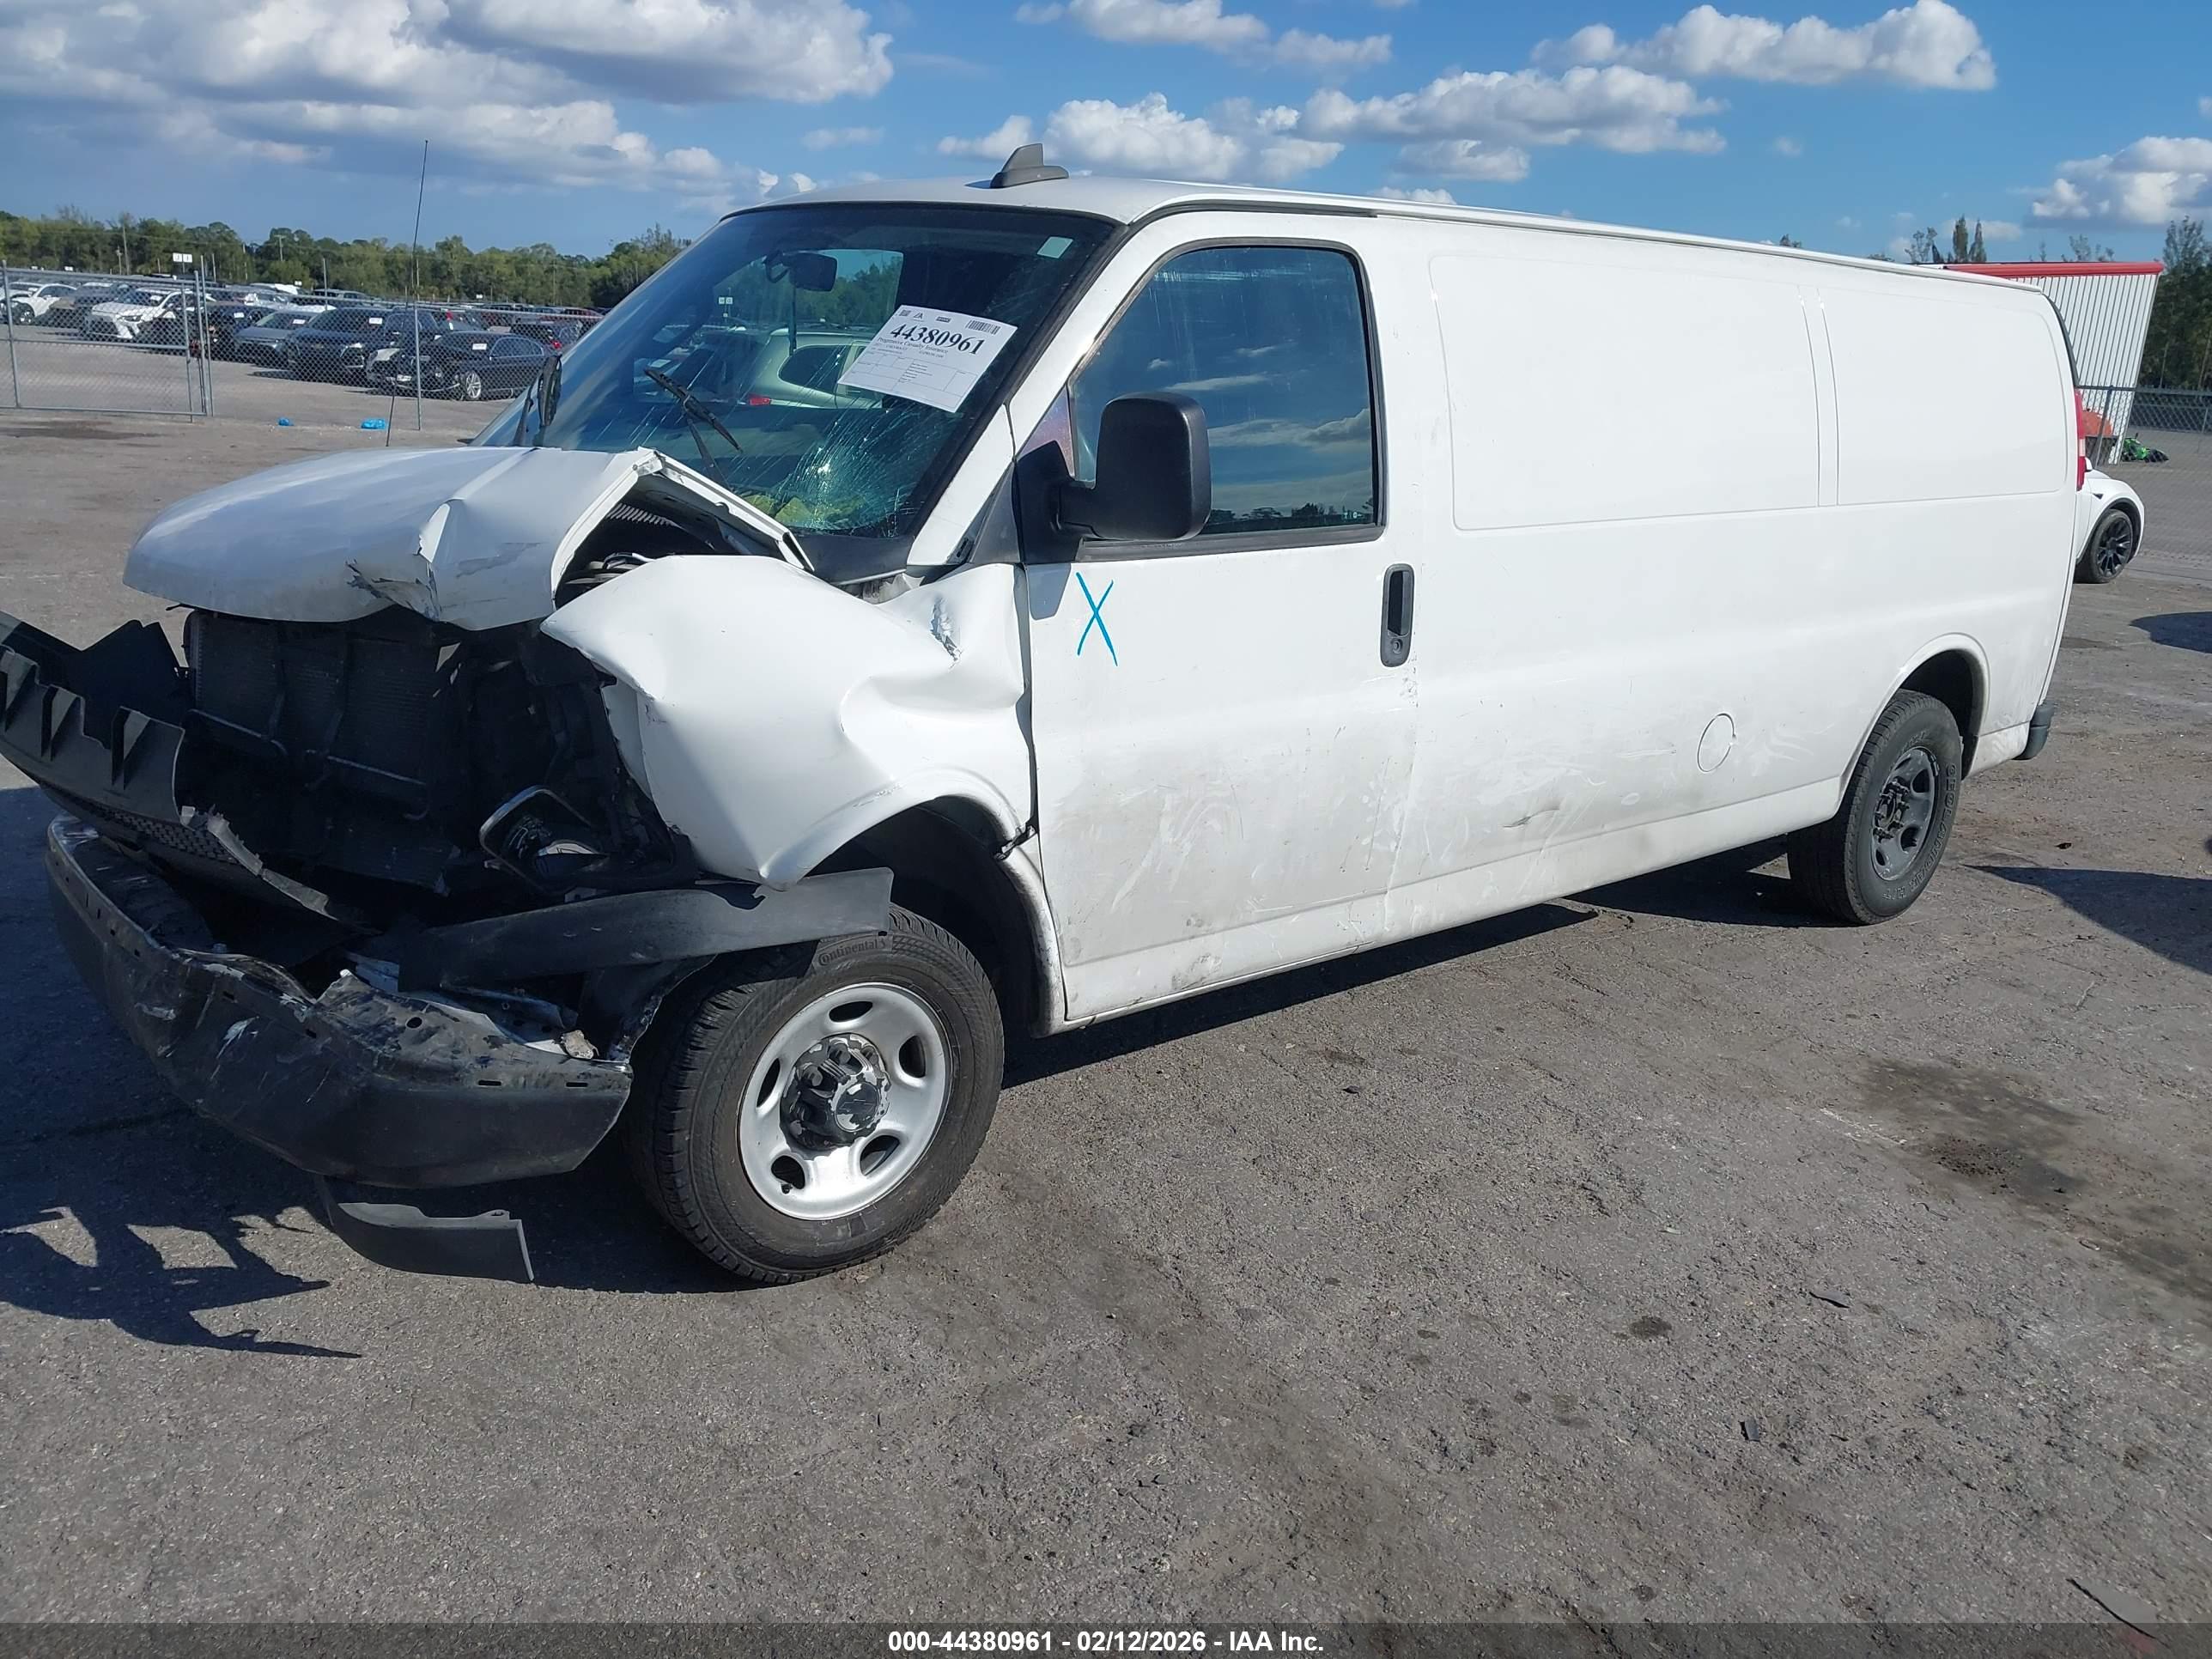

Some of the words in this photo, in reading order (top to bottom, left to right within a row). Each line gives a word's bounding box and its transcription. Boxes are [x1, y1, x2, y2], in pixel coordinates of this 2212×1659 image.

[890, 323, 986, 355] 44380961
[1076, 572, 1118, 666] X
[817, 939, 878, 966] Continental
